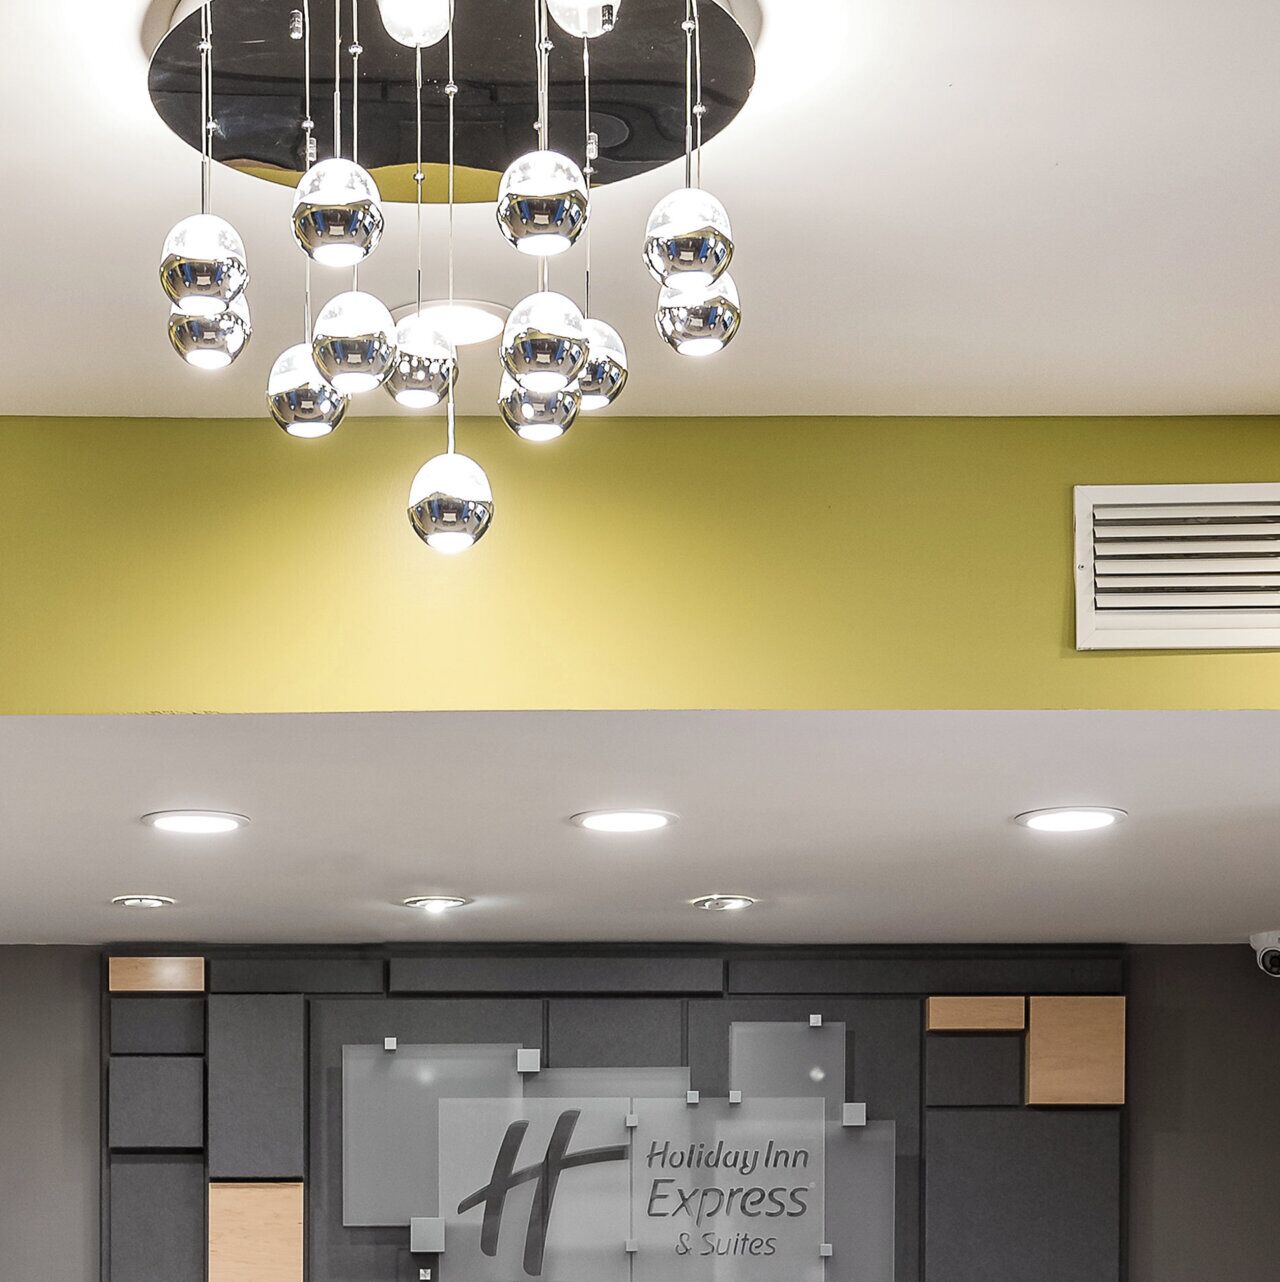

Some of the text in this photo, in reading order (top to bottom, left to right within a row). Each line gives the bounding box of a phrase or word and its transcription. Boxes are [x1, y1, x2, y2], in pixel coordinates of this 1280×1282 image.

[646, 1140, 810, 1176] Holiday Inn
[646, 1177, 810, 1229] Express
[675, 1232, 778, 1257] & Suites
